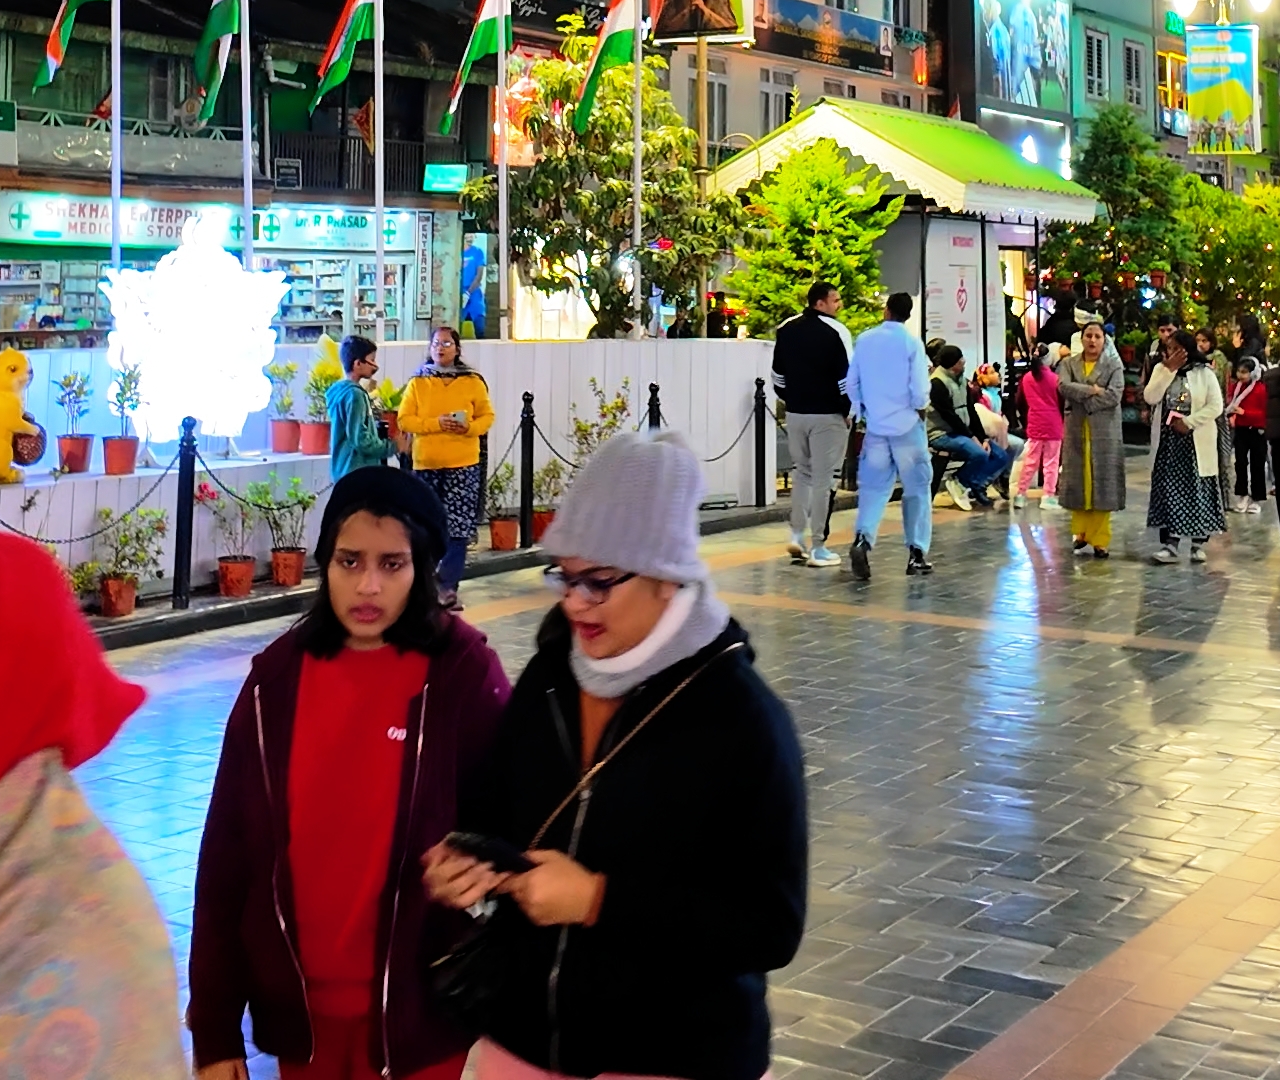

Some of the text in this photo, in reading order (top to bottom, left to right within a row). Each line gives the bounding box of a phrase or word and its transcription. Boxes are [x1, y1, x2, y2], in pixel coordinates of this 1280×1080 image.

[45, 201, 112, 220] SHEKHA
[327, 214, 368, 229] PRASAD
[147, 224, 183, 238] STOR
